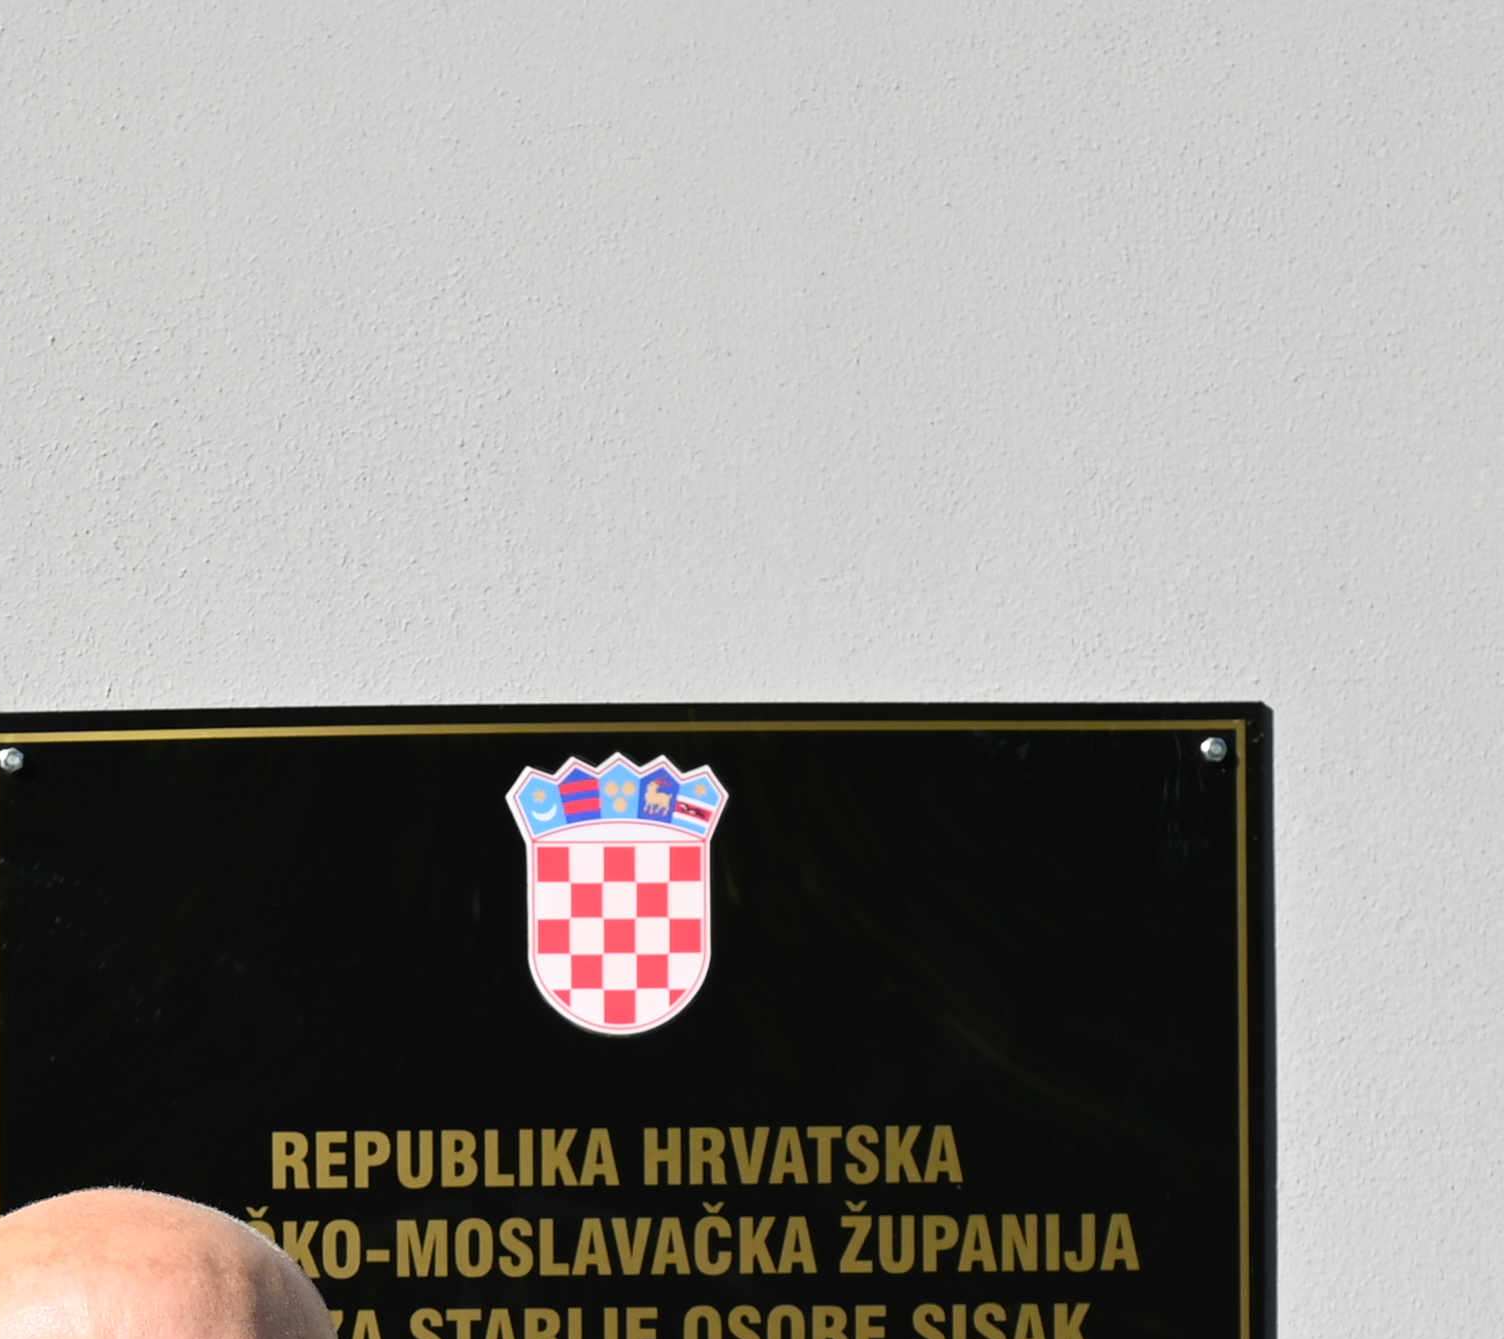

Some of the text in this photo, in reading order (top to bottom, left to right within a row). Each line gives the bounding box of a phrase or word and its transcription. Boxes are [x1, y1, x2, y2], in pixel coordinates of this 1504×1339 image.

[270, 1124, 963, 1190] REPUBLIKA HRVATSKA
[838, 1200, 1140, 1274] ŽUPANIJA
